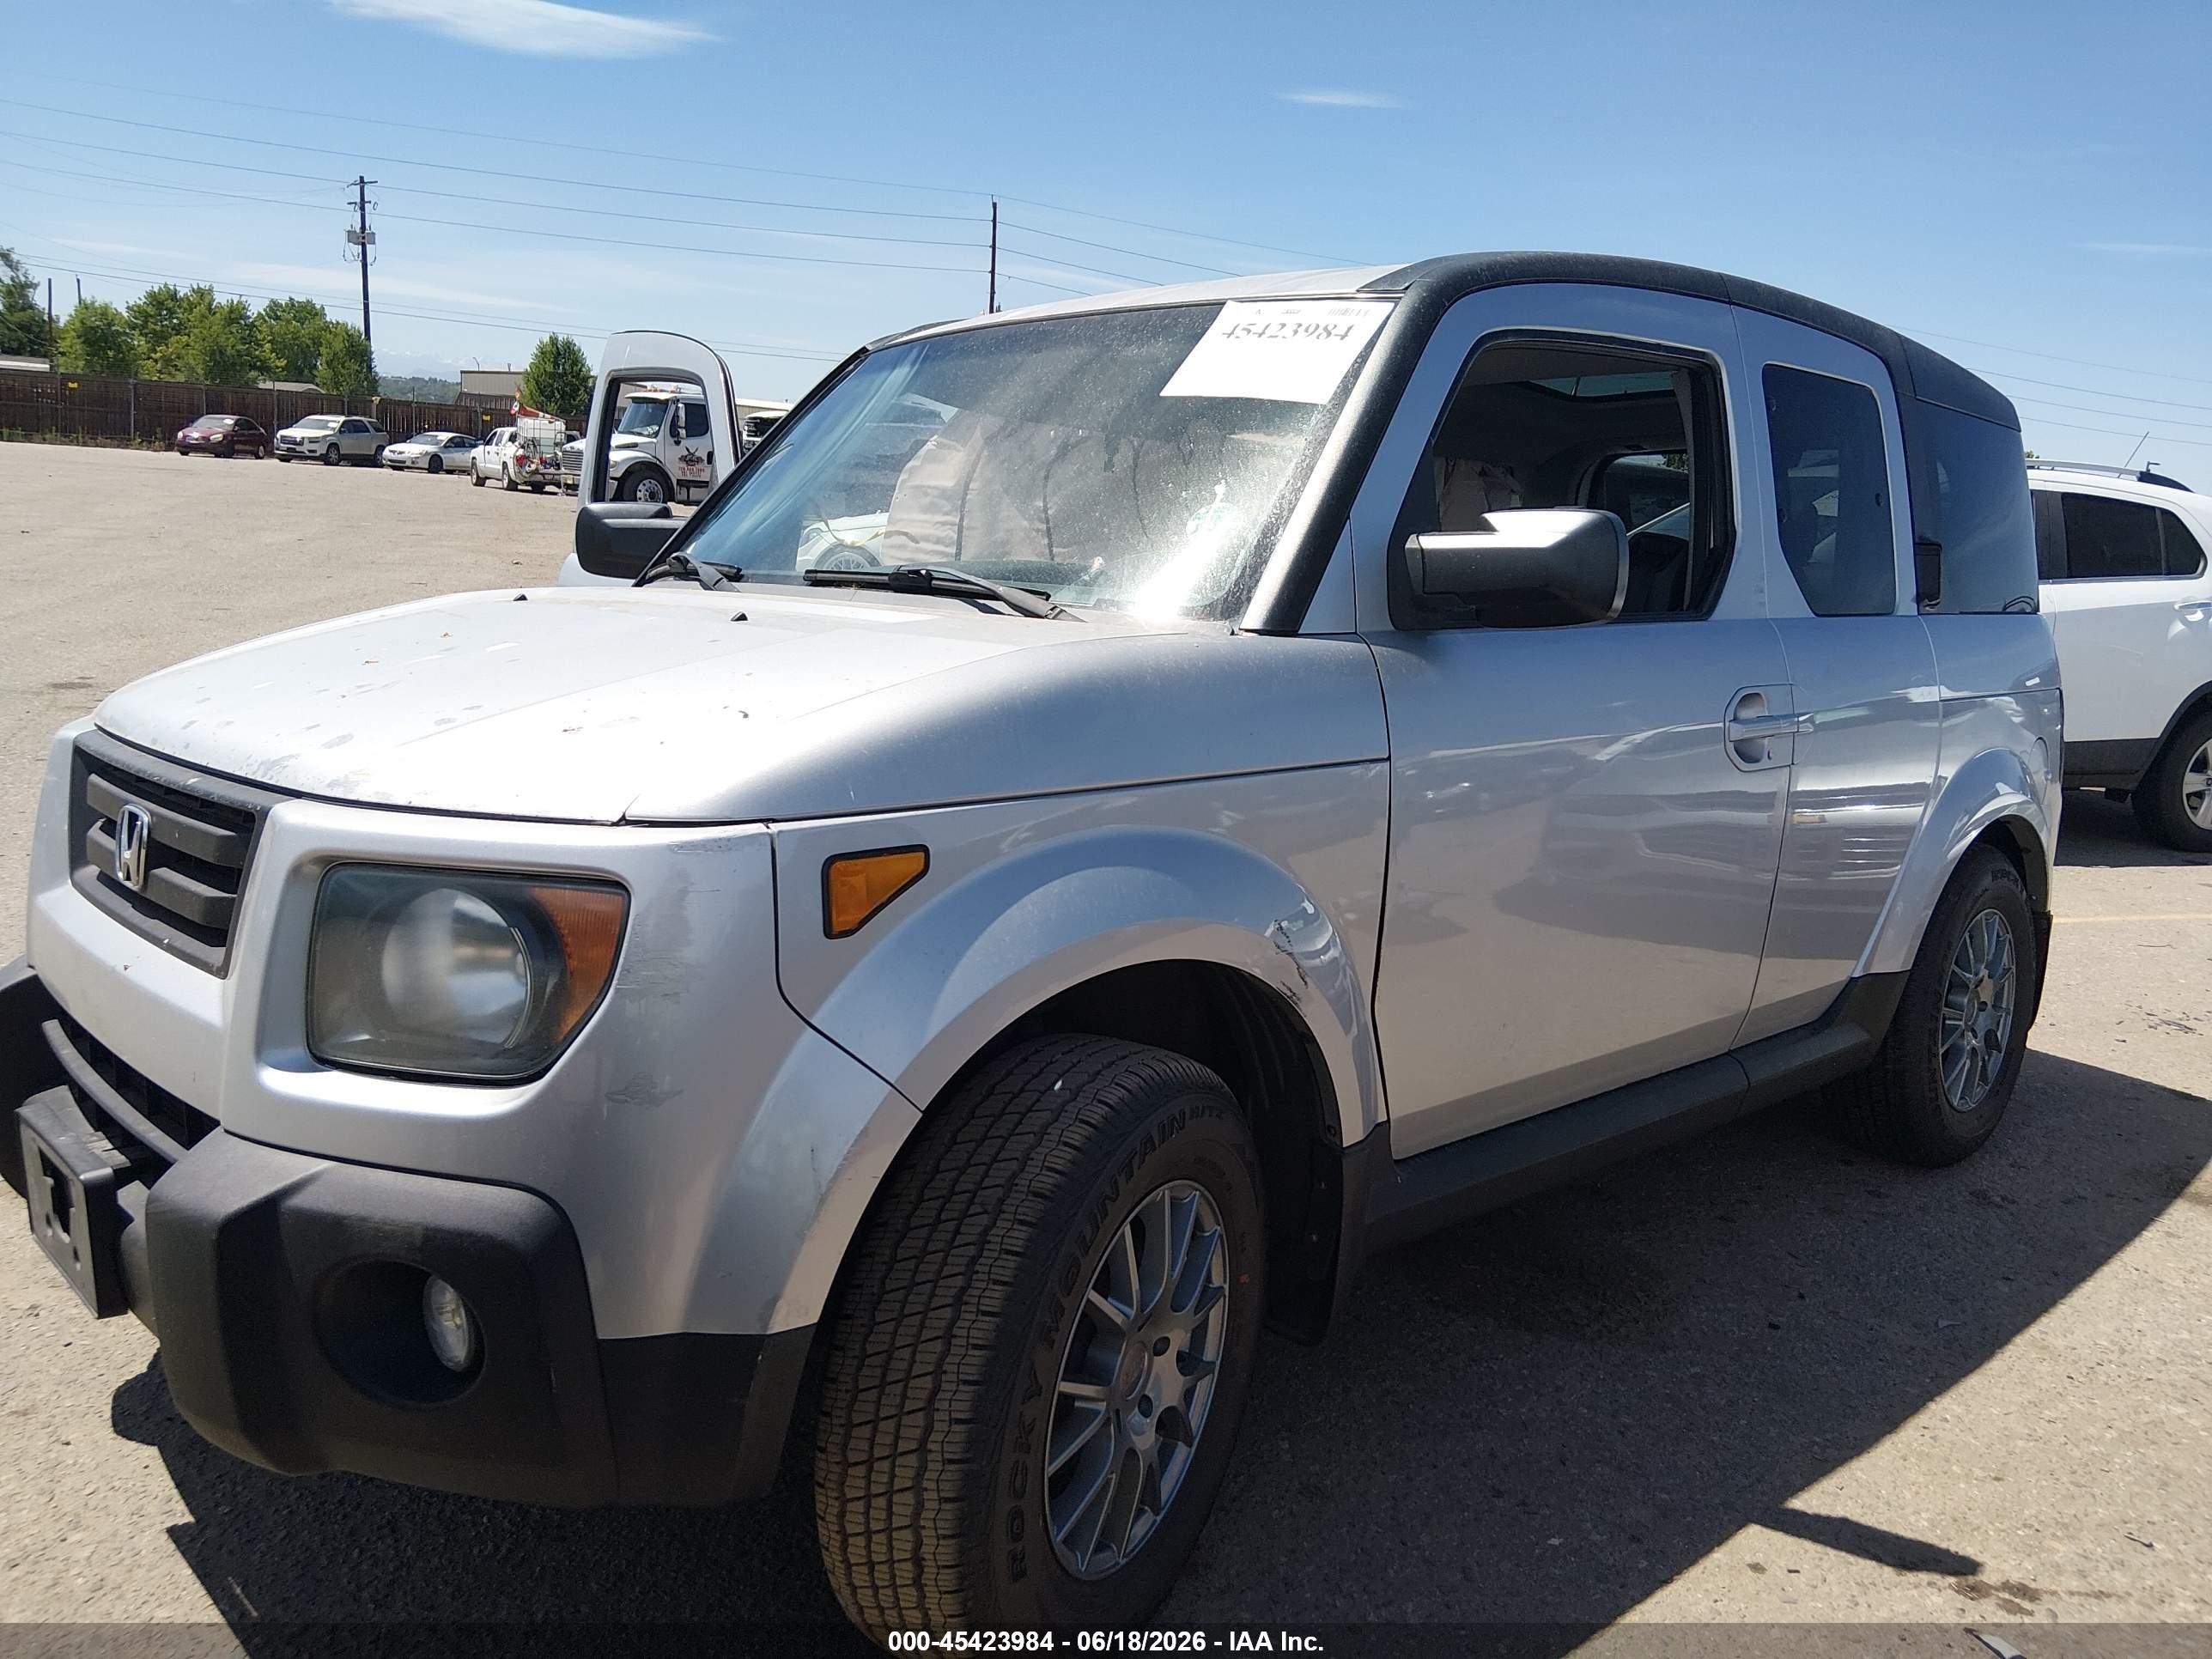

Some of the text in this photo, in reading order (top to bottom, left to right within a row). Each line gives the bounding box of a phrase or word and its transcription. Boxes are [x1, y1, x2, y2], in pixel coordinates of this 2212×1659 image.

[1222, 322, 1355, 341] 45423984
[1007, 1360, 1042, 1583] ROCKY
[1043, 1108, 1187, 1349] MOUNTAIN
